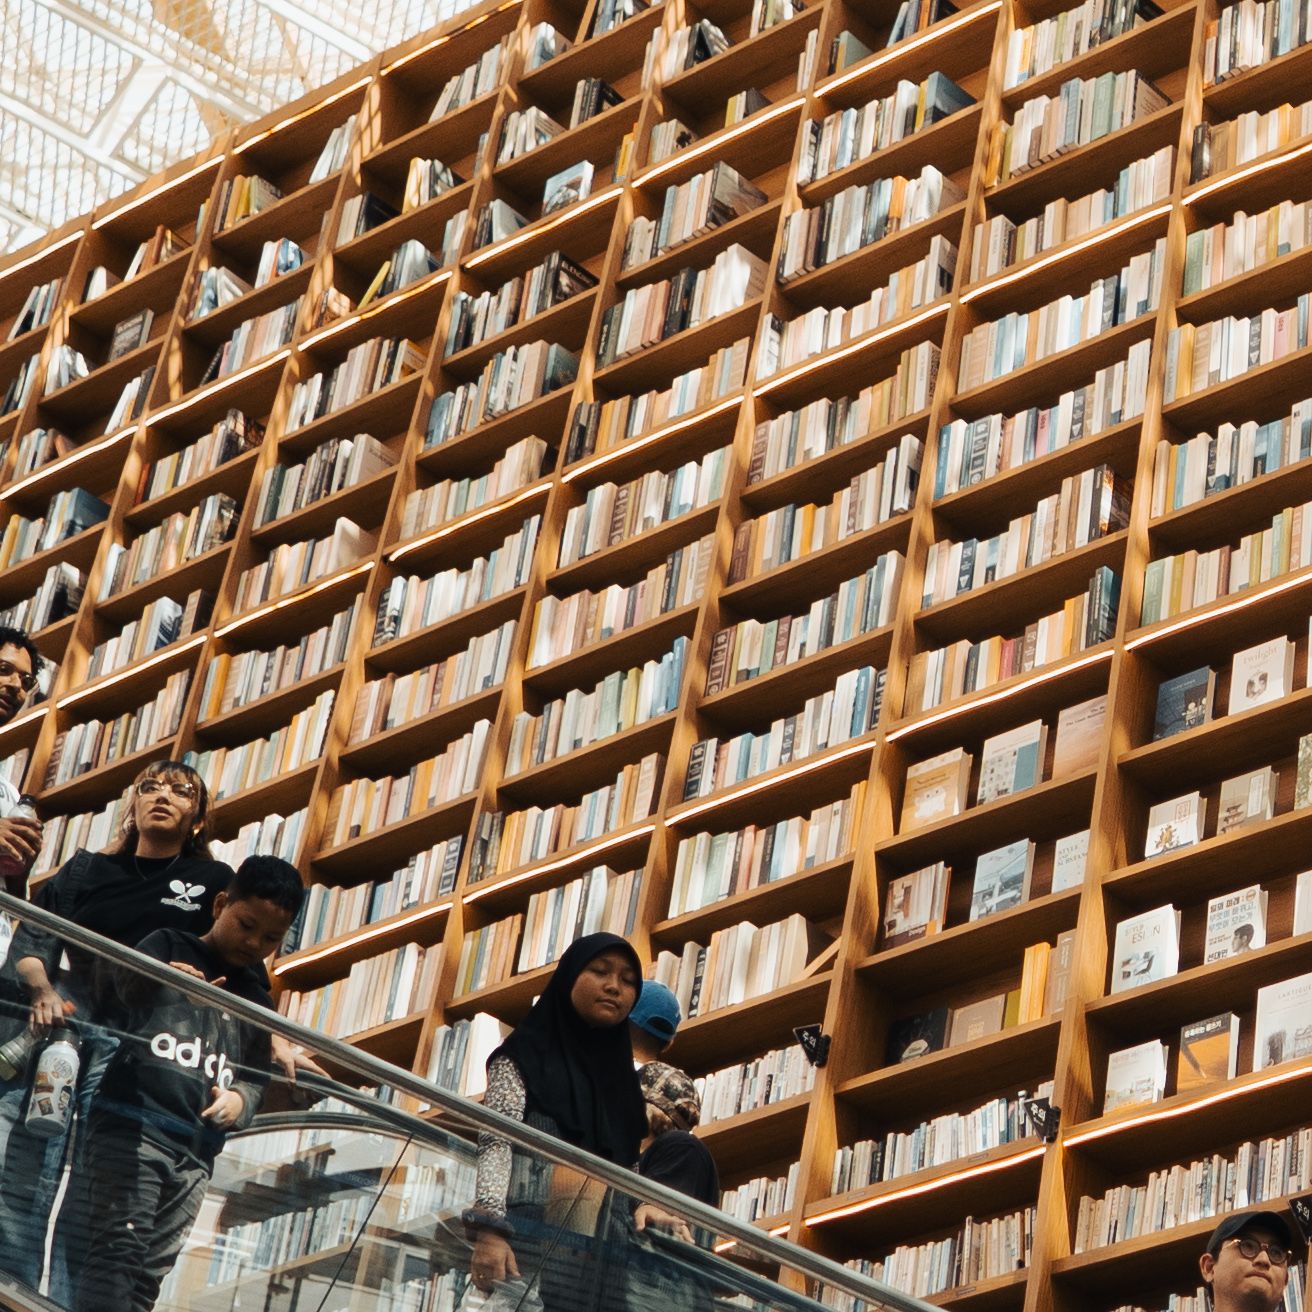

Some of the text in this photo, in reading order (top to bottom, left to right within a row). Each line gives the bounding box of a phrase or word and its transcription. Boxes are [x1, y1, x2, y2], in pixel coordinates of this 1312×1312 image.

[802, 1030, 817, 1048] 주의
[1030, 1102, 1047, 1120] 주의
[1295, 1200, 1310, 1221] 주의
